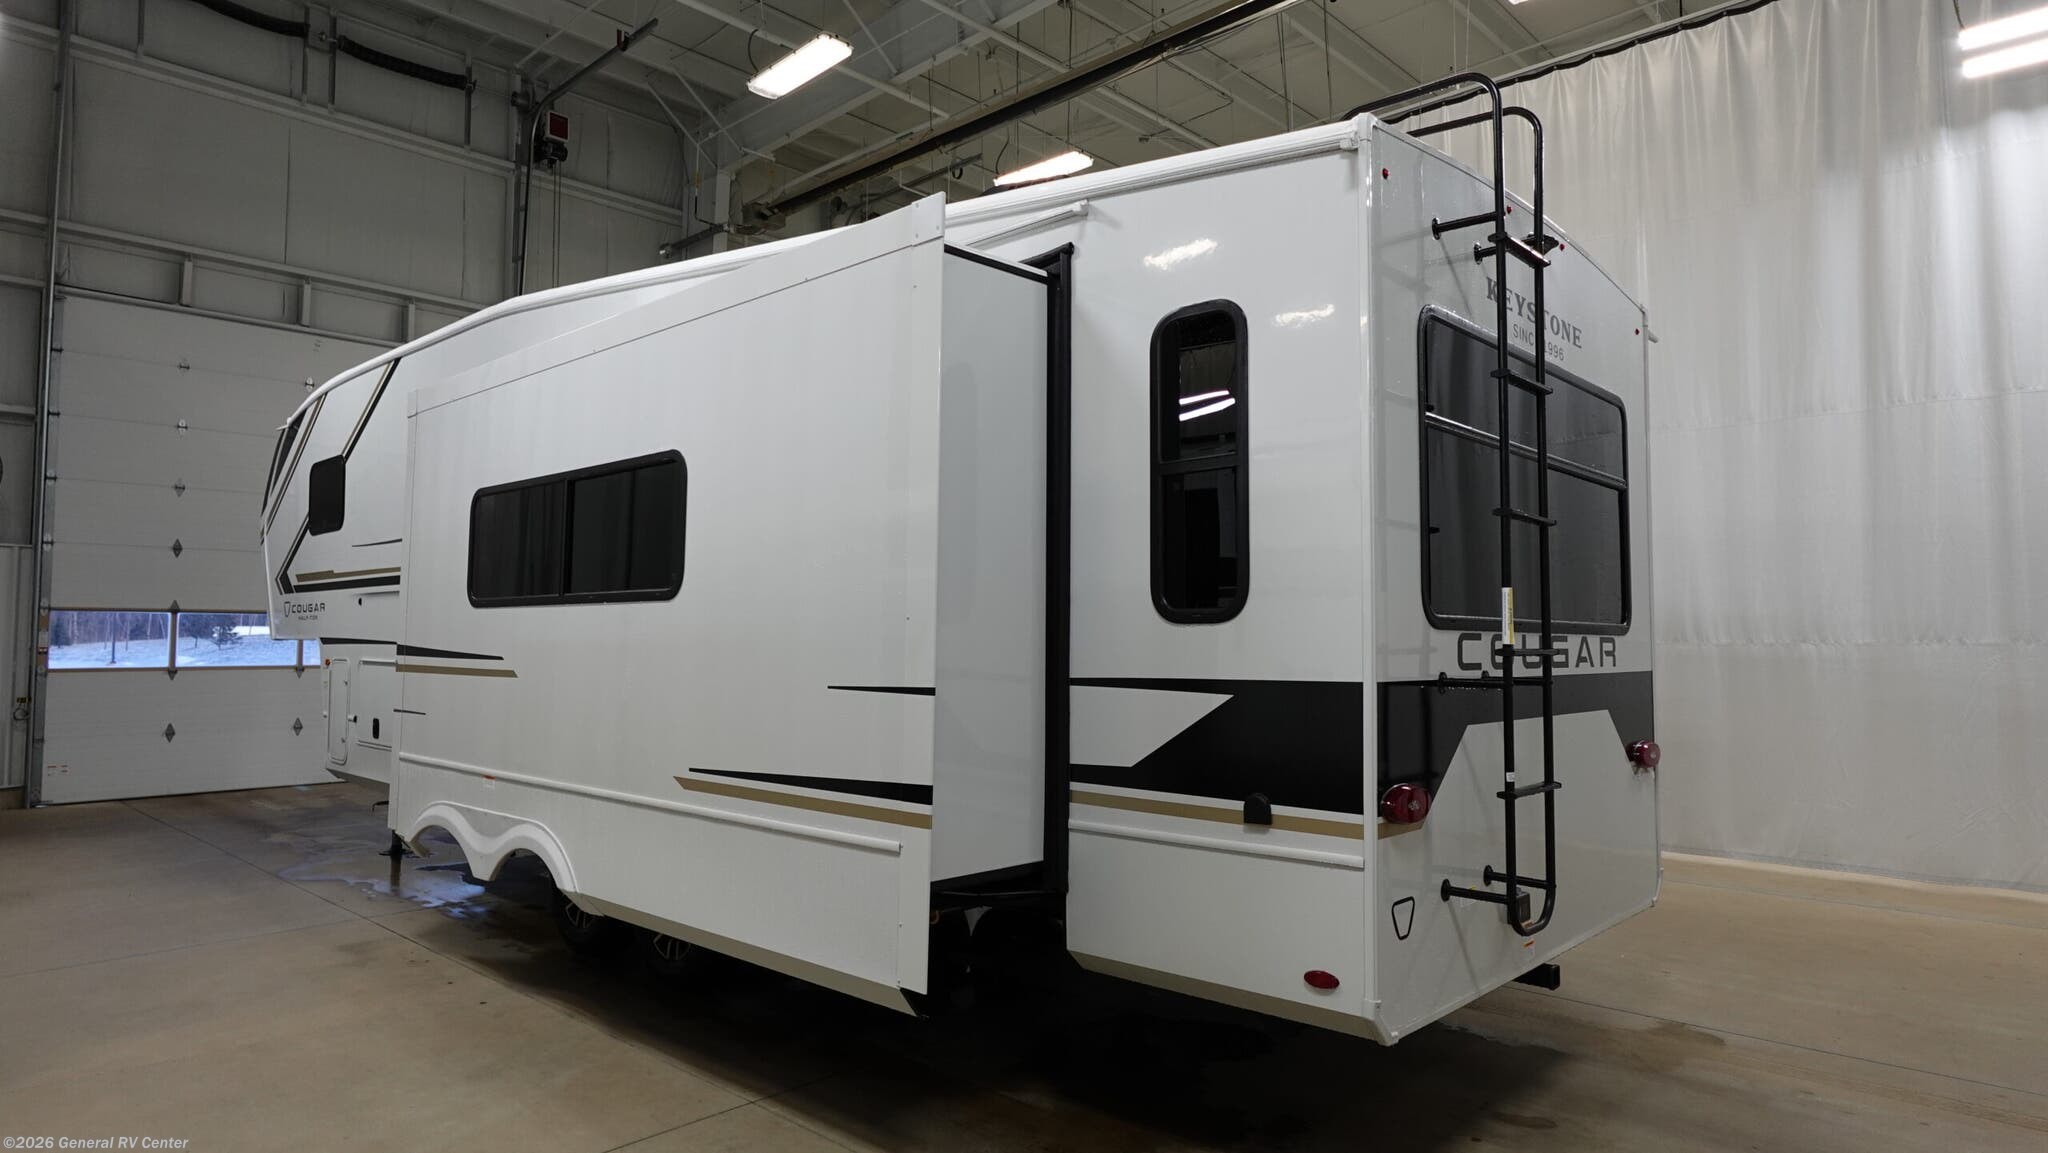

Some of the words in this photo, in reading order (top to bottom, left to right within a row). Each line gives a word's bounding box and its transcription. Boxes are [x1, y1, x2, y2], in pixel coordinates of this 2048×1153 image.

[1513, 323, 1538, 346] SINC
[1542, 341, 1565, 361] 996
[291, 603, 326, 614] COUGAR
[1457, 632, 1617, 671] COUGAR
